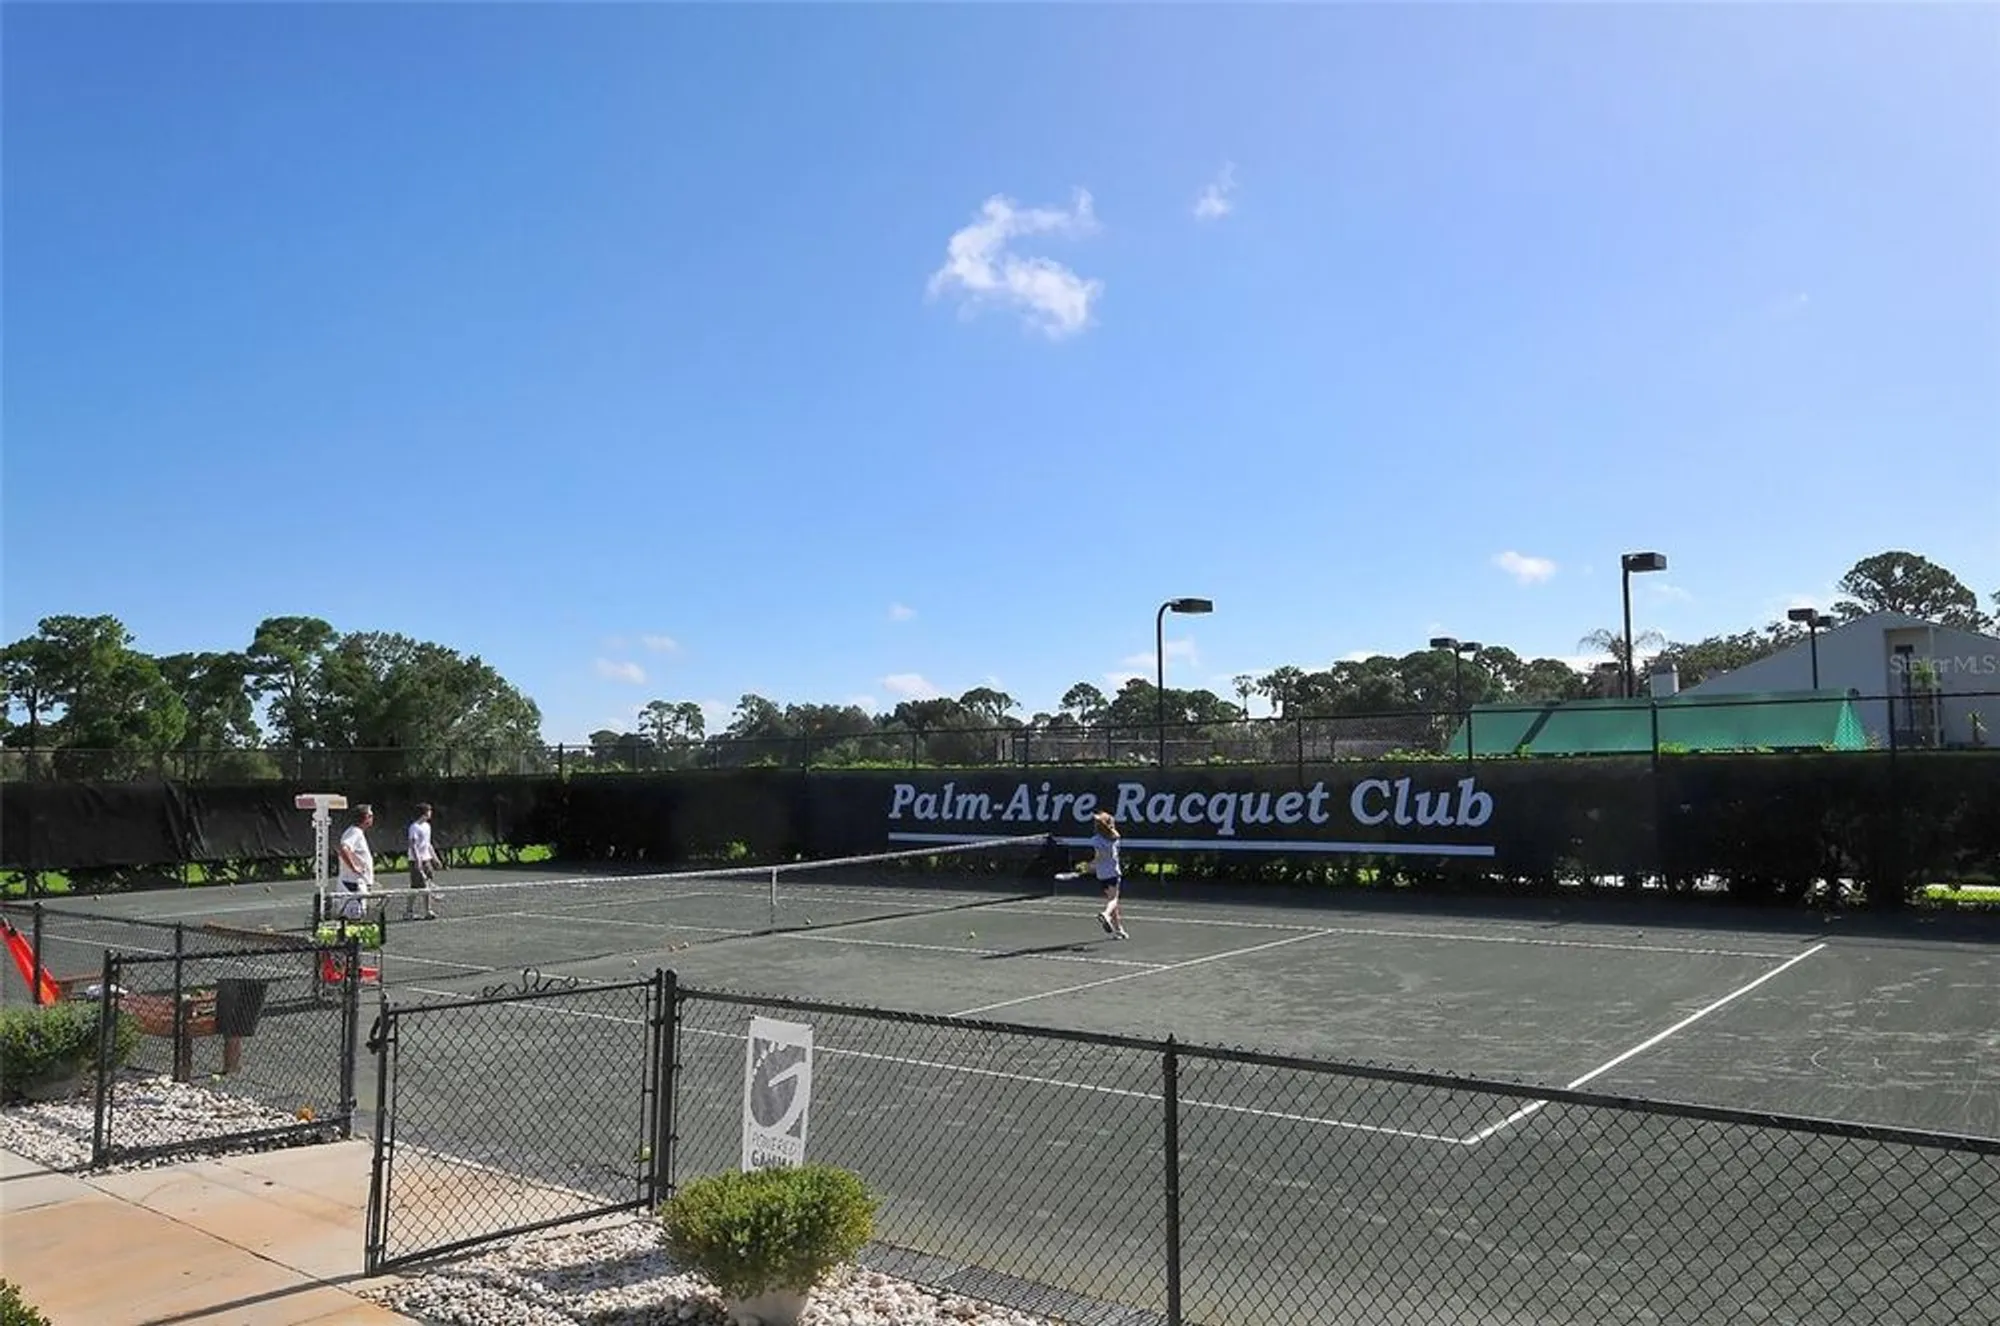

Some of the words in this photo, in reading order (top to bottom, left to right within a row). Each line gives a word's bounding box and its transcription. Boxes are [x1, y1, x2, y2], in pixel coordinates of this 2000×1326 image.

[888, 780, 1097, 823] Palm-Aire
[1115, 780, 1329, 836] Racquet
[1349, 776, 1494, 828] Club
